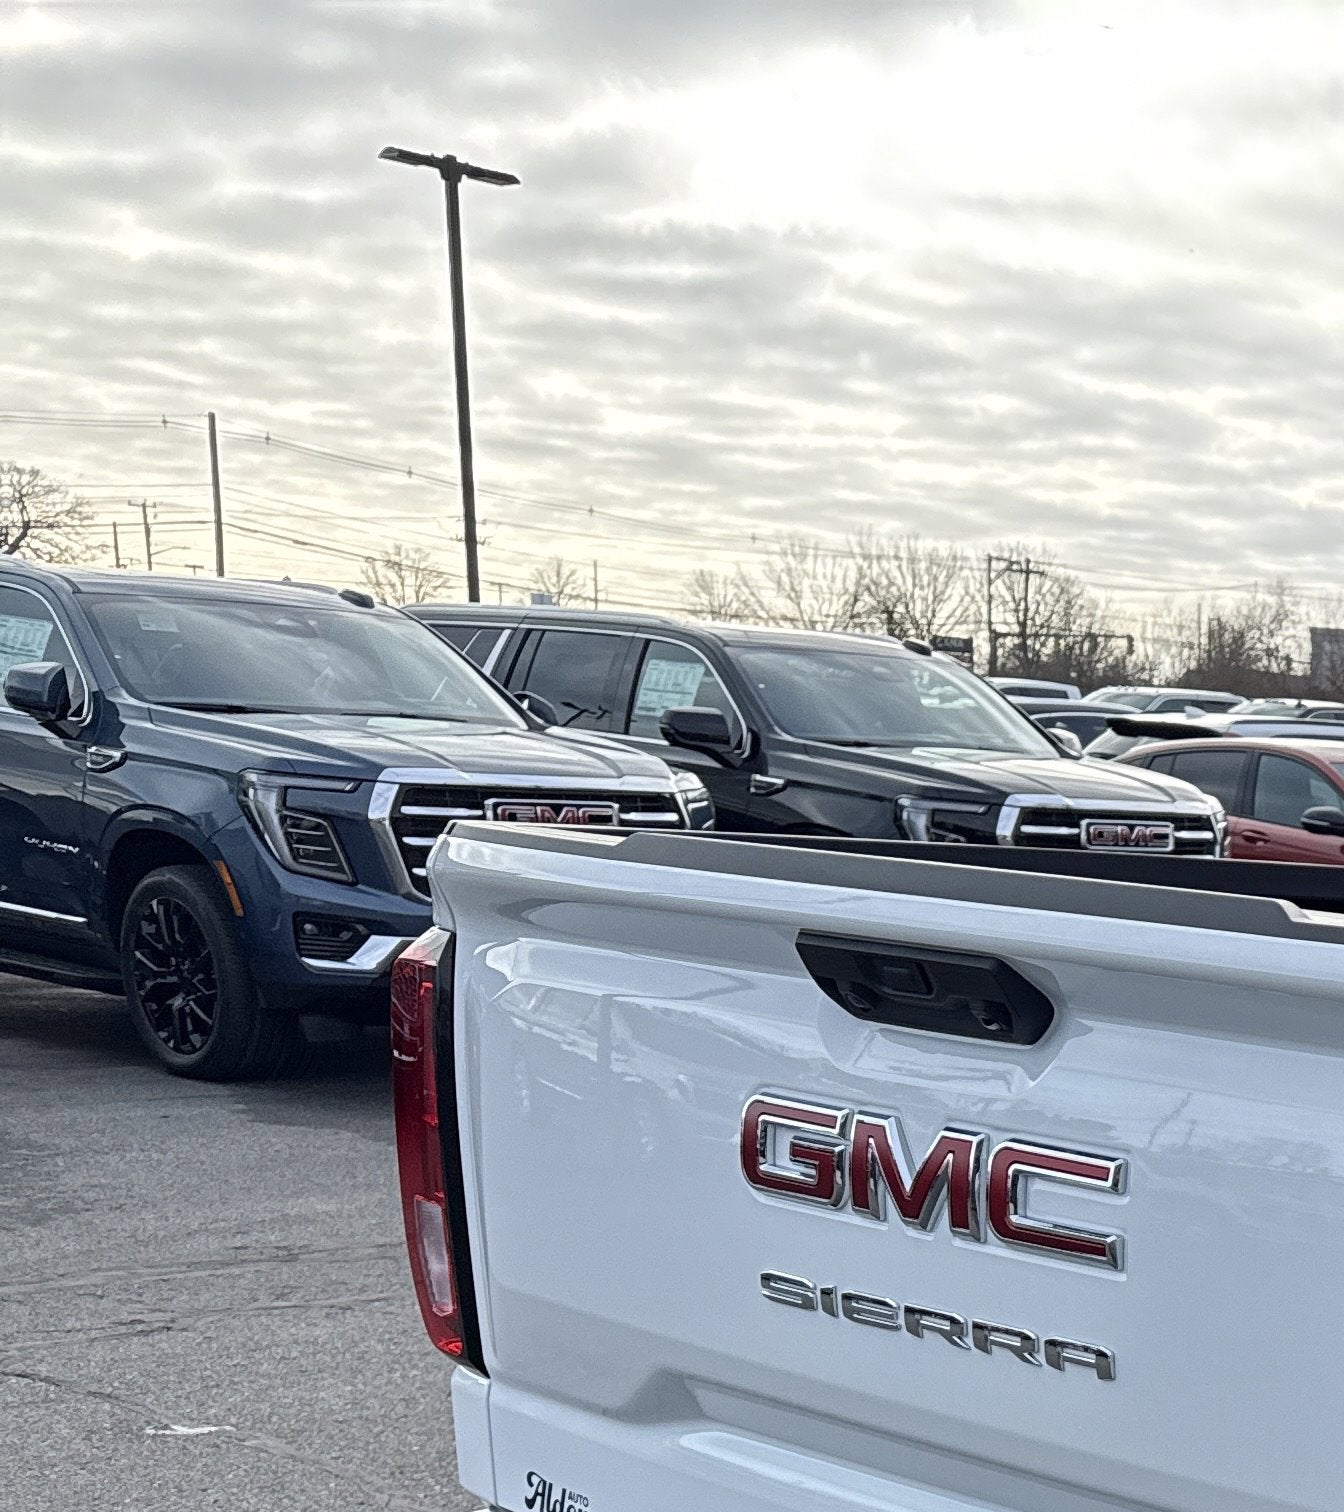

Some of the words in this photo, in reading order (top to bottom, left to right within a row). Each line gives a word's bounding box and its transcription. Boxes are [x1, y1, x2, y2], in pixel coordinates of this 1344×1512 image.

[497, 805, 613, 825] GMC
[1089, 825, 1170, 846] GMC
[740, 1093, 1128, 1271] GMC
[760, 1269, 1117, 1382] SIERRA
[568, 1491, 589, 1508] AUTO
